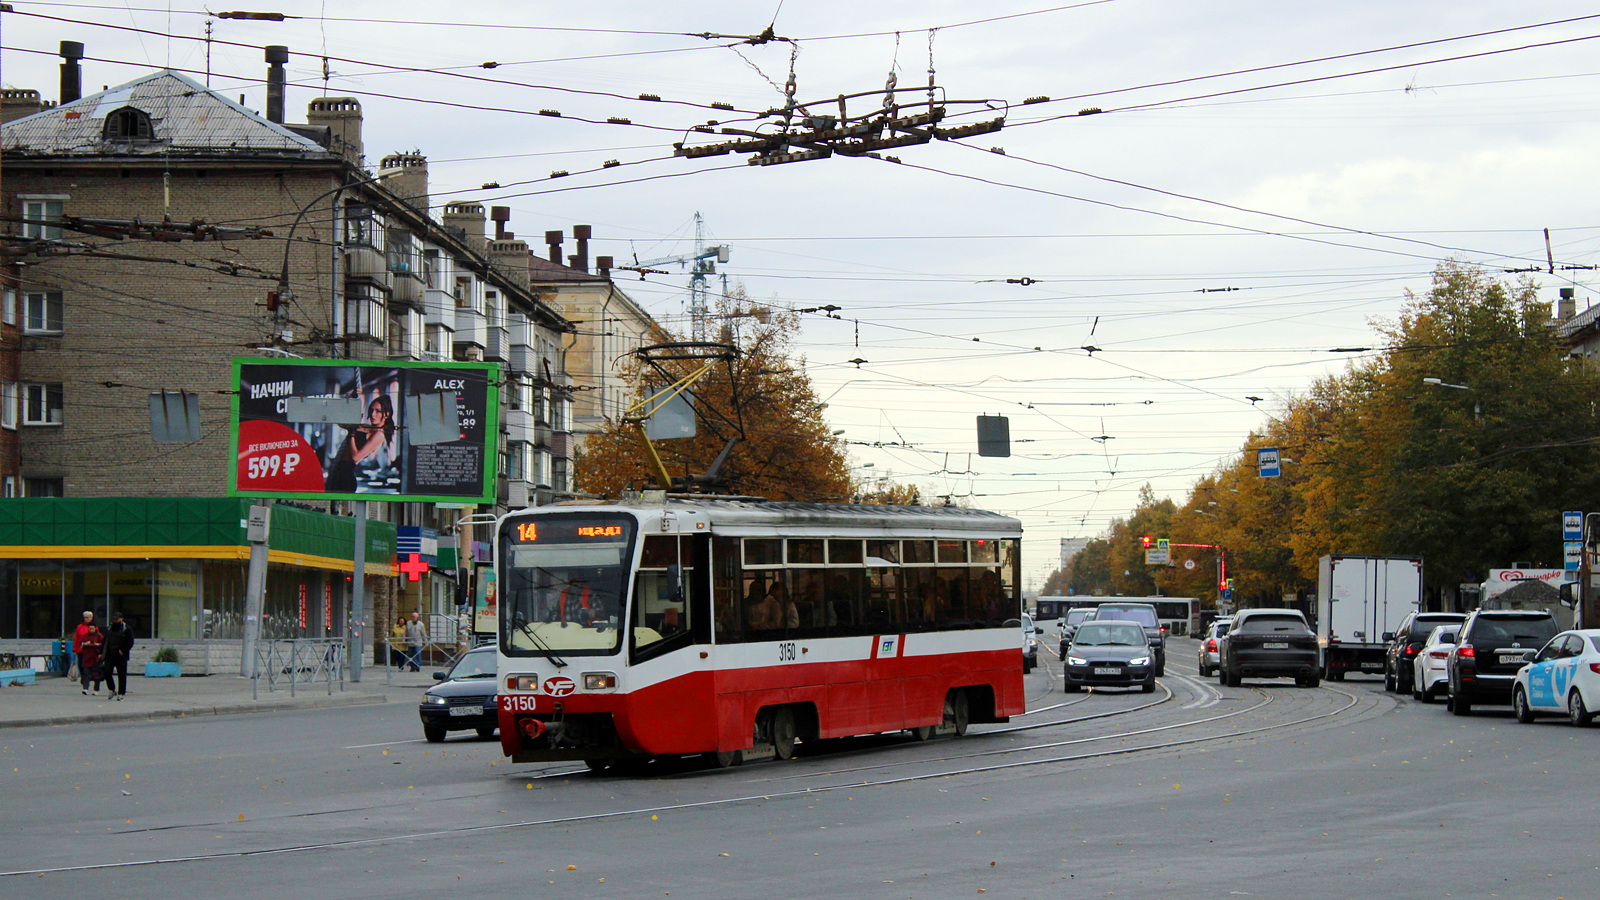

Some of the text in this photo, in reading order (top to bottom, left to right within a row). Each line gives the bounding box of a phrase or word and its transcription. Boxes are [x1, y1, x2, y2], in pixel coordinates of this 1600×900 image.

[251, 380, 293, 400] НАЧНИ
[434, 379, 465, 390] ALEX
[249, 439, 299, 452] ВСЕ ВКЛЮЧЕНО ЗА
[248, 454, 281, 479] 599
[517, 522, 537, 541] 14
[779, 642, 796, 661] 3150
[503, 696, 536, 711] 3150
